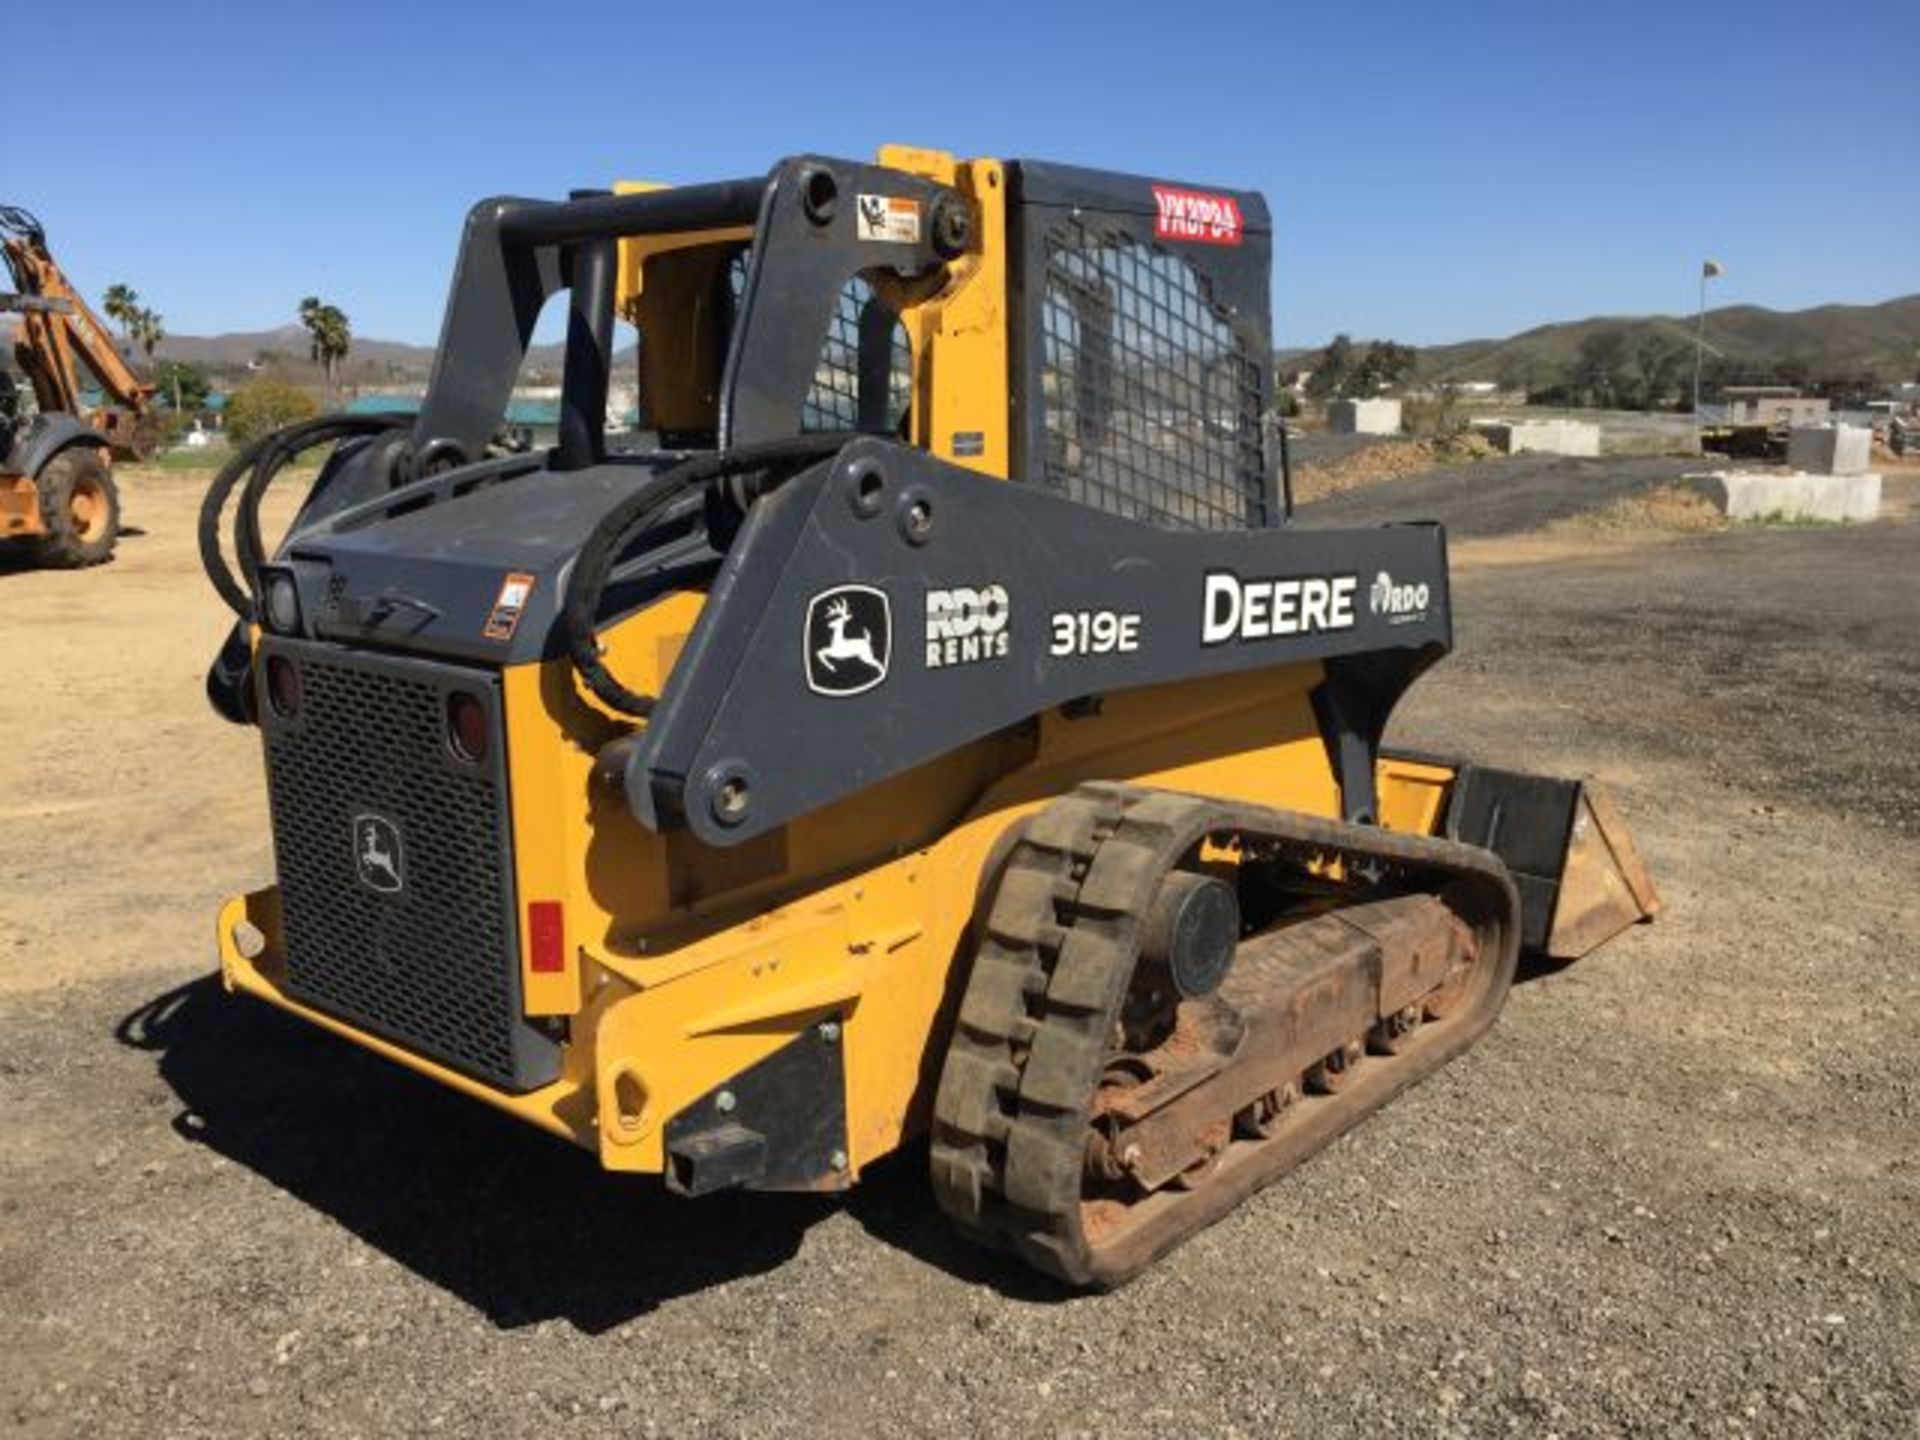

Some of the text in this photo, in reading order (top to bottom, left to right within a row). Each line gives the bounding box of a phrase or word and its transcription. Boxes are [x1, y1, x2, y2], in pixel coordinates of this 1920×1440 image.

[926, 584, 1008, 640] RDO
[1203, 572, 1356, 643] DEERE
[1391, 582, 1429, 613] RDO
[926, 632, 1008, 667] RENTS
[1051, 612, 1141, 656] 319E
